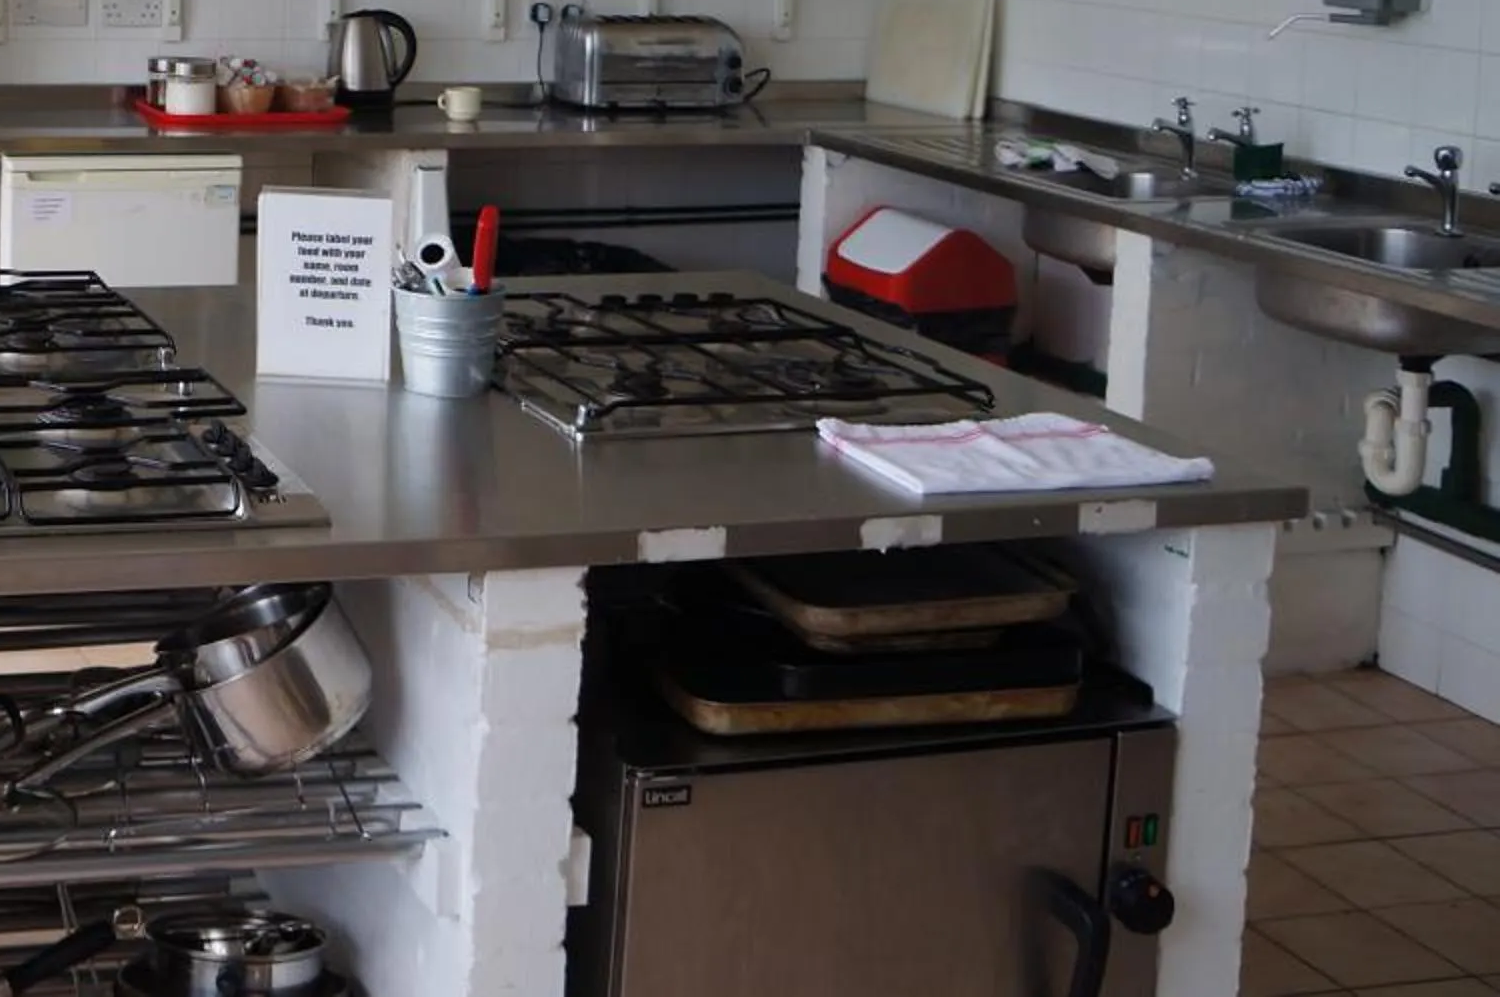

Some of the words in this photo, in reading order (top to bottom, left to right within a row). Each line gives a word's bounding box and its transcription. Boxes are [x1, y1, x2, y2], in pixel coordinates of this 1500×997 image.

[291, 231, 324, 242] Please
[325, 233, 350, 244] label
[351, 235, 373, 246] your
[297, 246, 320, 256] food
[321, 248, 342, 257] with
[343, 249, 366, 259] your
[333, 263, 359, 272] room
[330, 276, 349, 286] and
[350, 277, 372, 287] date
[305, 316, 334, 328] Thank
